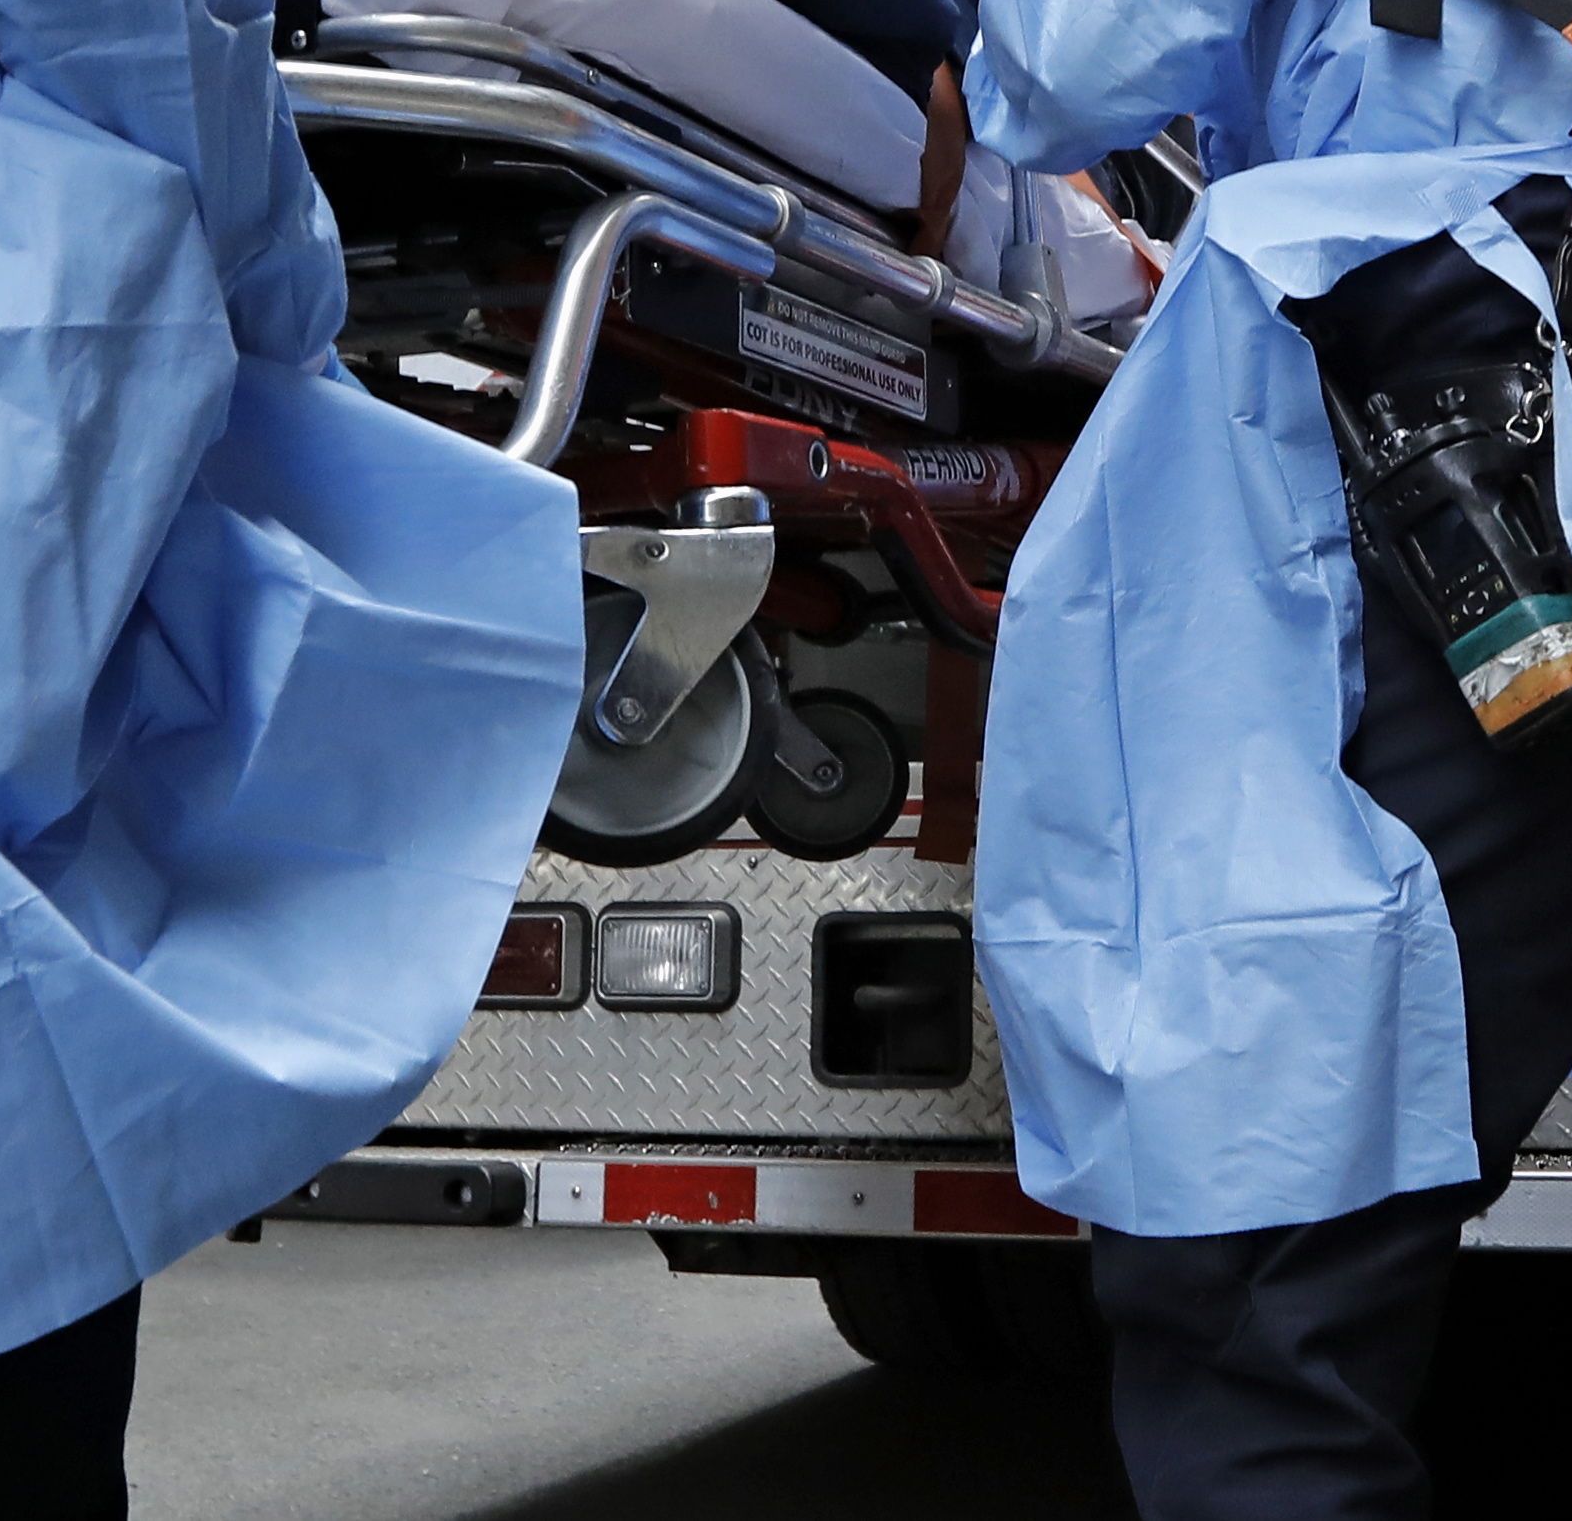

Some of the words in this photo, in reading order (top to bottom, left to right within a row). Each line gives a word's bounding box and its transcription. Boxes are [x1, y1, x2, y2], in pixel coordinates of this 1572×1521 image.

[747, 322, 768, 344] COT
[770, 328, 780, 348] IS
[782, 334, 803, 357] FOR
[804, 343, 877, 386] PROFESSIONAL
[878, 372, 897, 394] USE
[898, 380, 921, 403] ONLY
